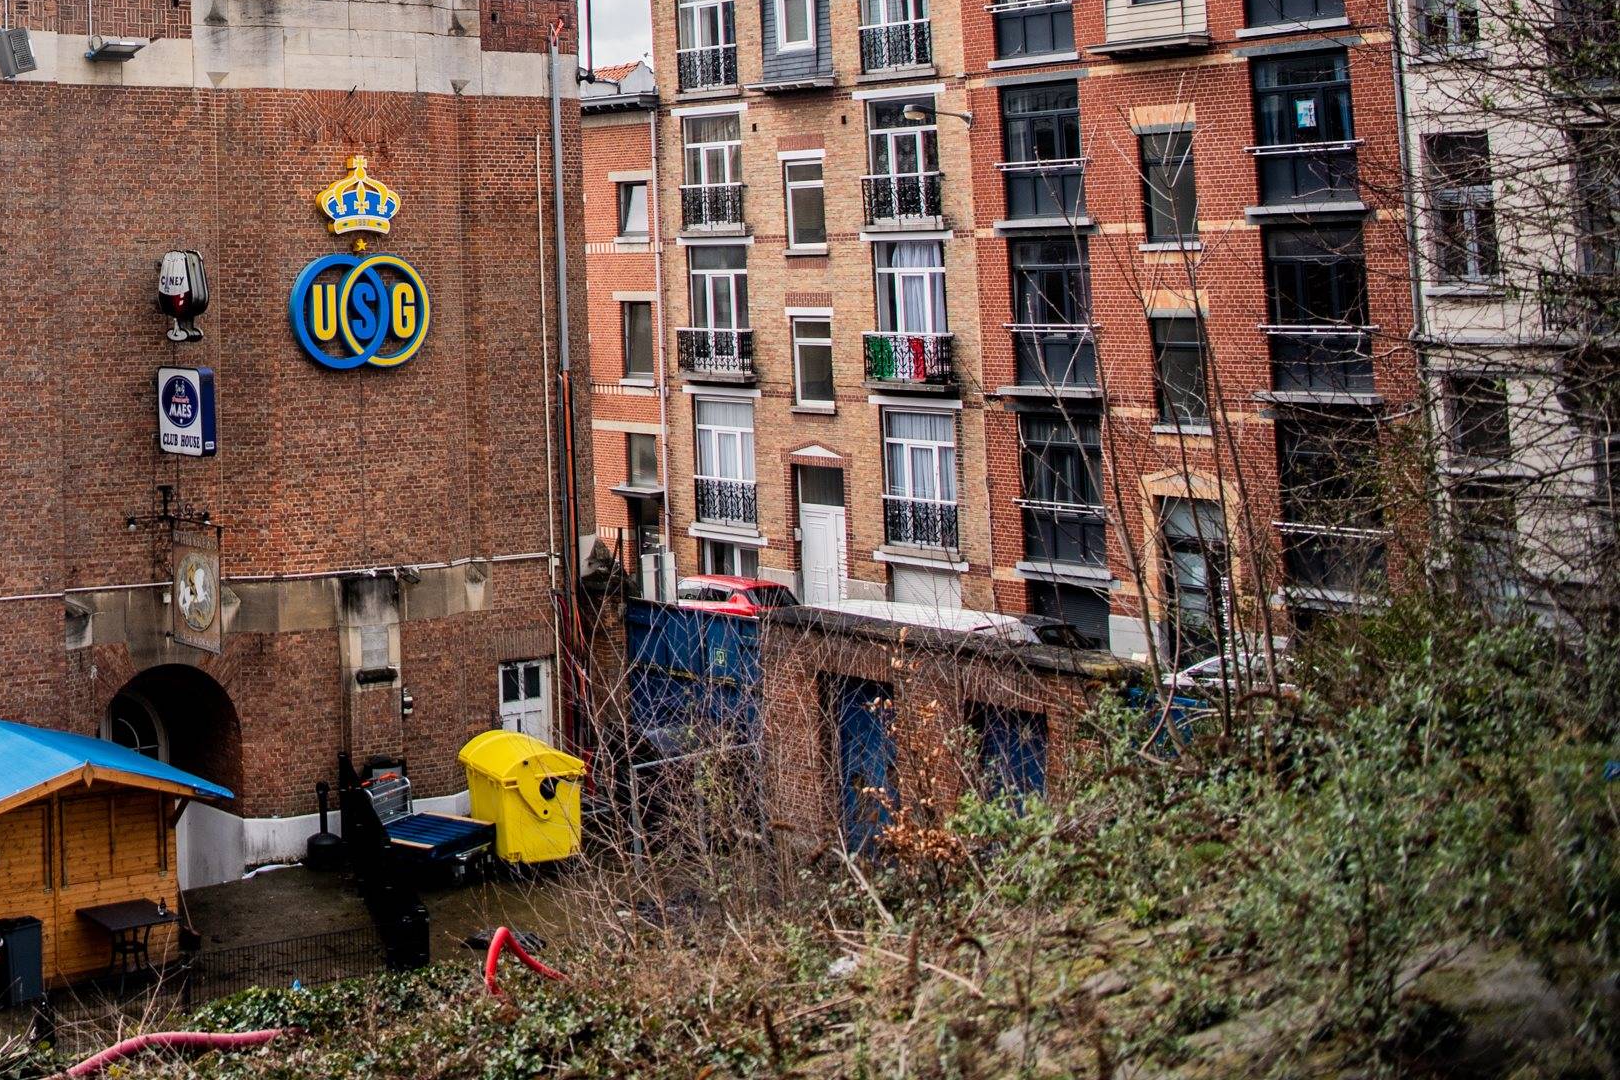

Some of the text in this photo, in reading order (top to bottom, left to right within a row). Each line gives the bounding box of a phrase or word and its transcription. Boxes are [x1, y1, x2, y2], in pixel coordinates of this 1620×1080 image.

[161, 276, 184, 286] CINEY
[169, 404, 192, 418] MAES
[163, 433, 178, 446] CLUB
[181, 434, 200, 449] HOUSE
